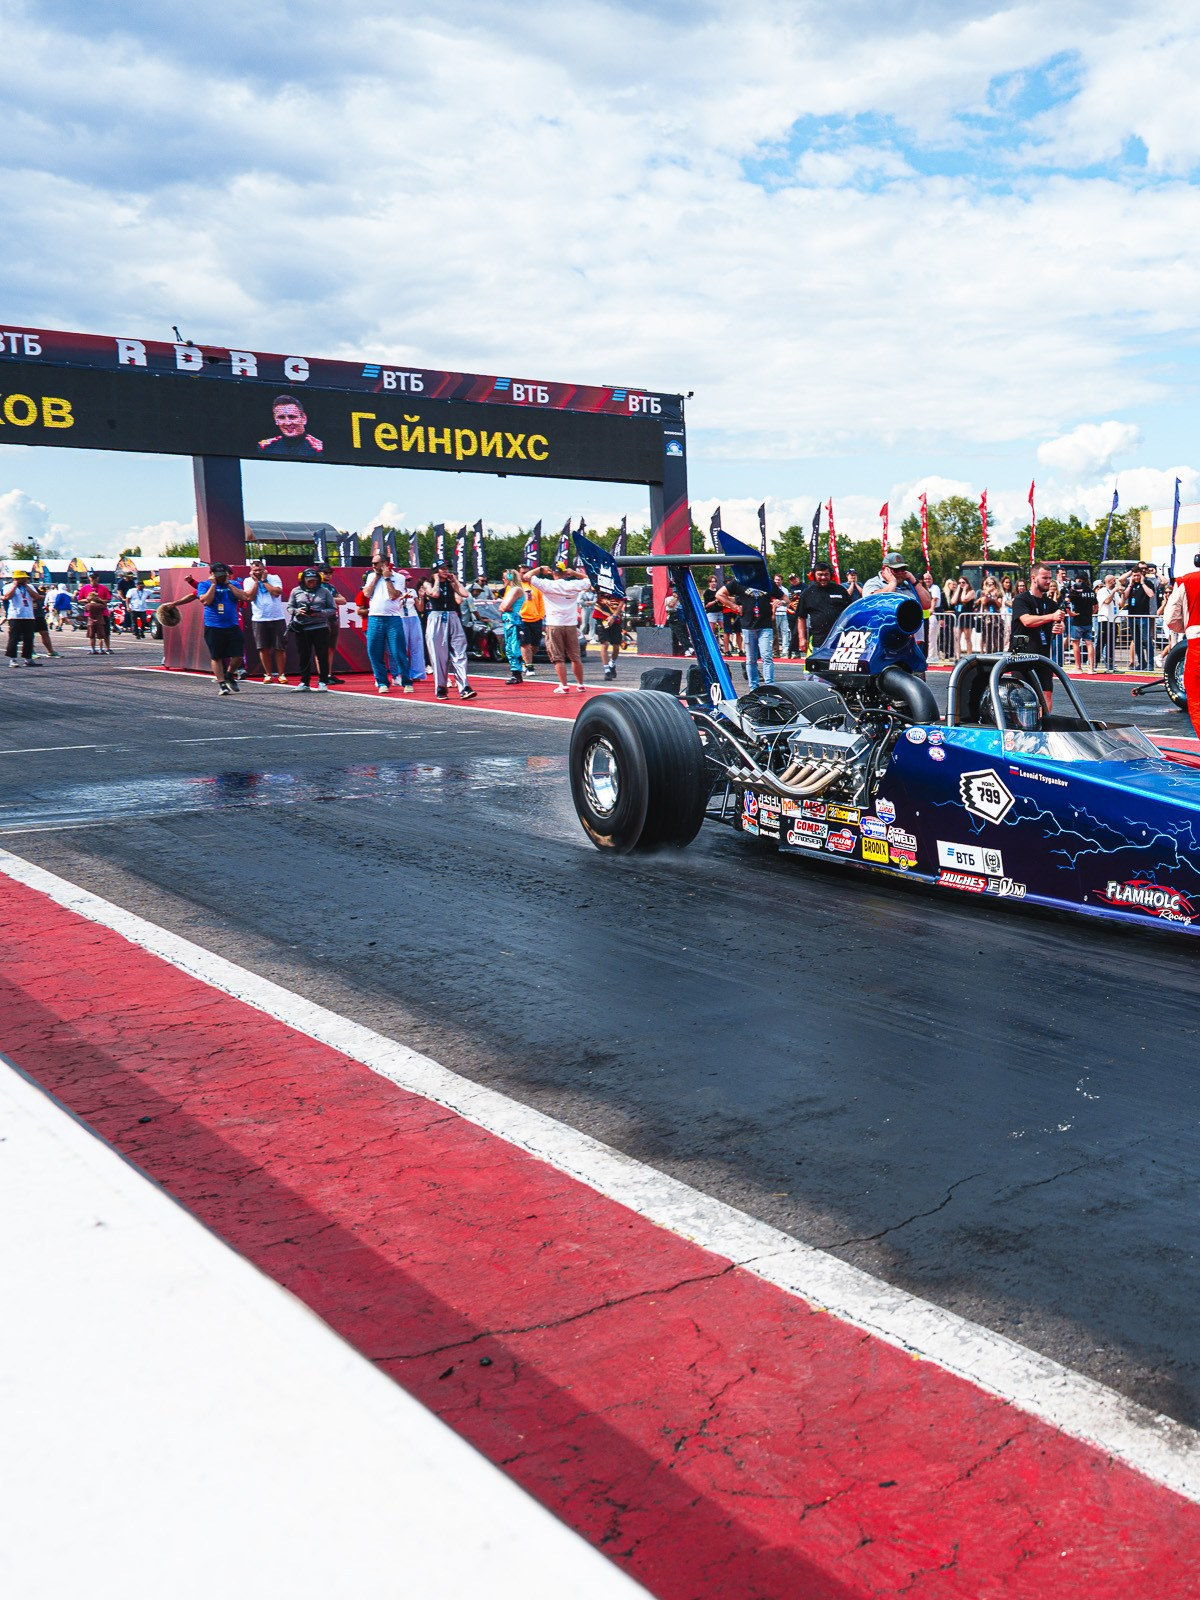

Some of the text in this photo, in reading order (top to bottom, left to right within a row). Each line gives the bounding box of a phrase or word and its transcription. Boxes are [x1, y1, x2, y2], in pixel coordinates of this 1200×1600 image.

[383, 370, 424, 392] ВТБ
[512, 383, 550, 404] ВТБ
[0, 393, 75, 429] ов
[628, 395, 662, 414] ВТБ
[351, 411, 549, 461] Гейнрихс
[837, 631, 872, 648] MAX
[1019, 769, 1069, 787] Leonid Tsygankov
[977, 786, 1001, 805] 799
[796, 820, 820, 832] COMP
[893, 832, 916, 845] WELD
[864, 839, 887, 856] BRODIX
[956, 851, 975, 866] ВТБ
[940, 872, 986, 888] HUGHES
[1158, 909, 1192, 926] Racing
